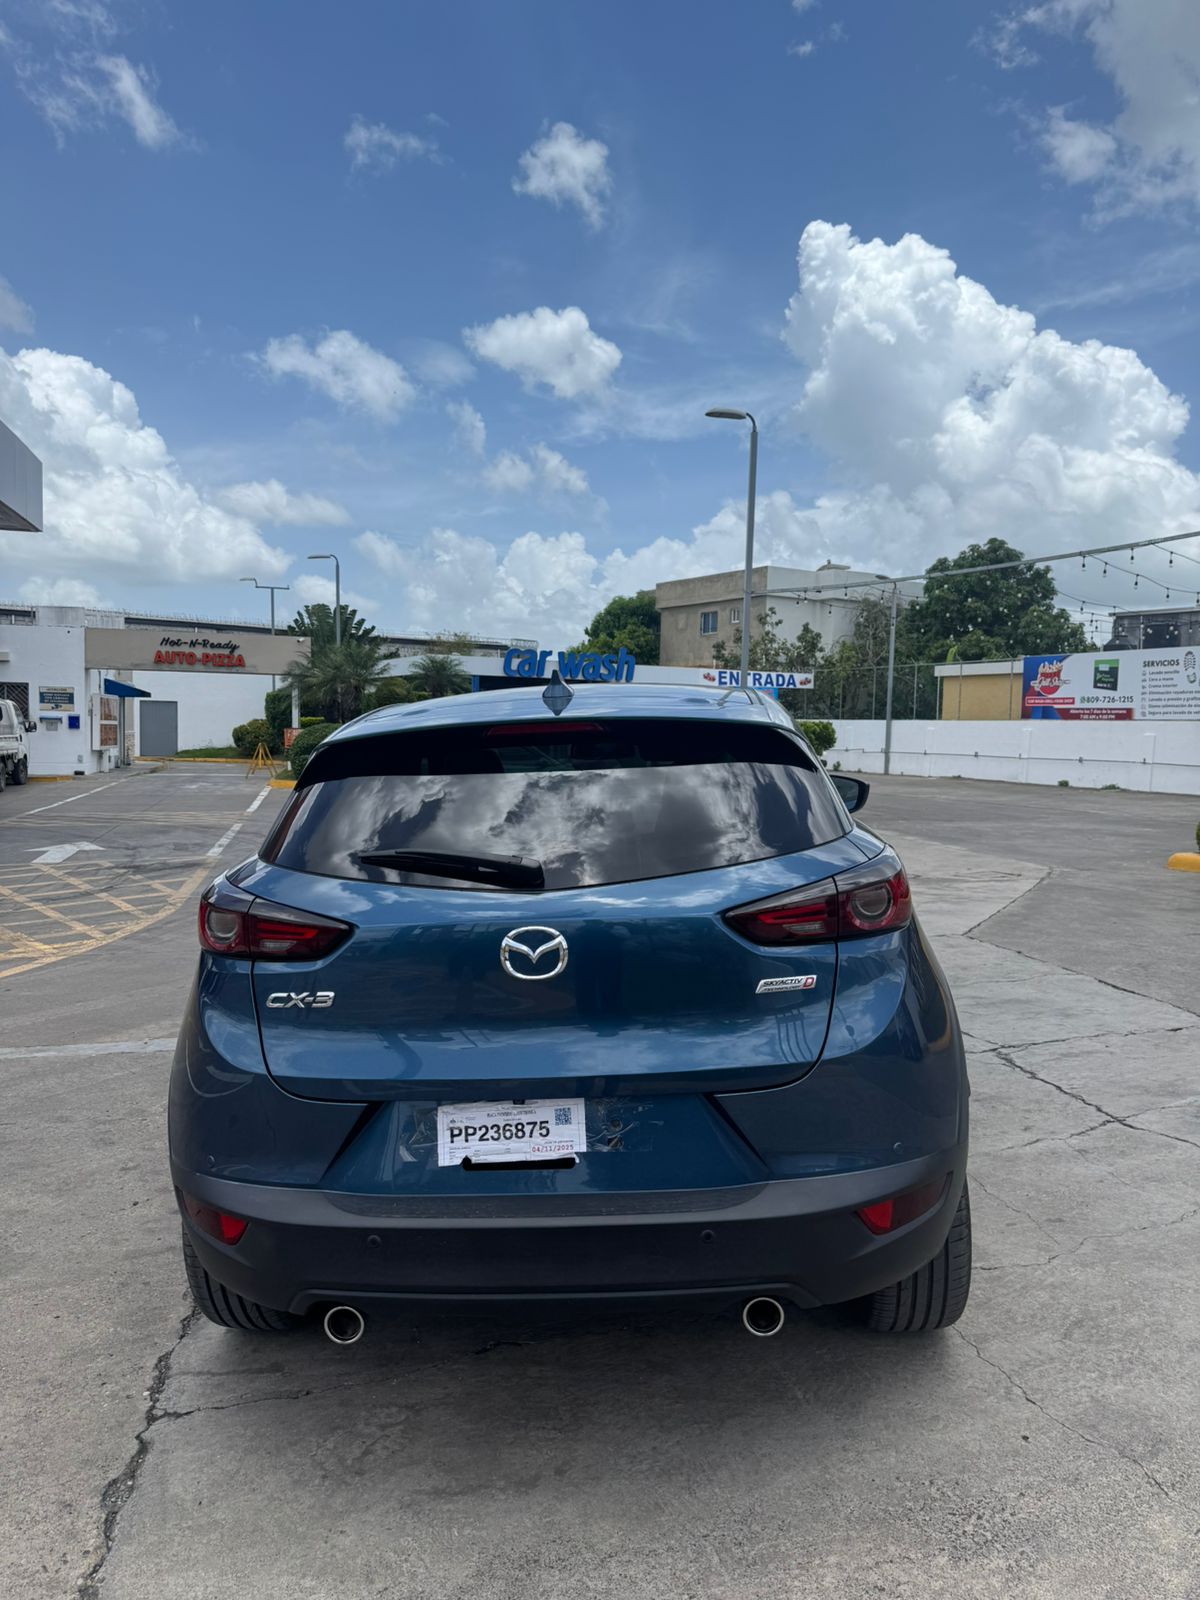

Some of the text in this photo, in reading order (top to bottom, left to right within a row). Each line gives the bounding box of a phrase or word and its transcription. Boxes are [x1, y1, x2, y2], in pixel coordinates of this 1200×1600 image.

[160, 637, 240, 653] Hot-N-Ready
[153, 650, 246, 667] AUTO-PIZZA
[503, 647, 635, 682] car wash
[1143, 659, 1180, 668] SERVICIOS
[718, 670, 797, 687] ENRADA
[1086, 695, 1134, 704] 809-726-1215
[763, 978, 804, 987] SKYACTIV
[266, 991, 335, 1008] CX-3
[449, 1120, 550, 1144] PP236875
[531, 1144, 574, 1153] 04/11/2025
